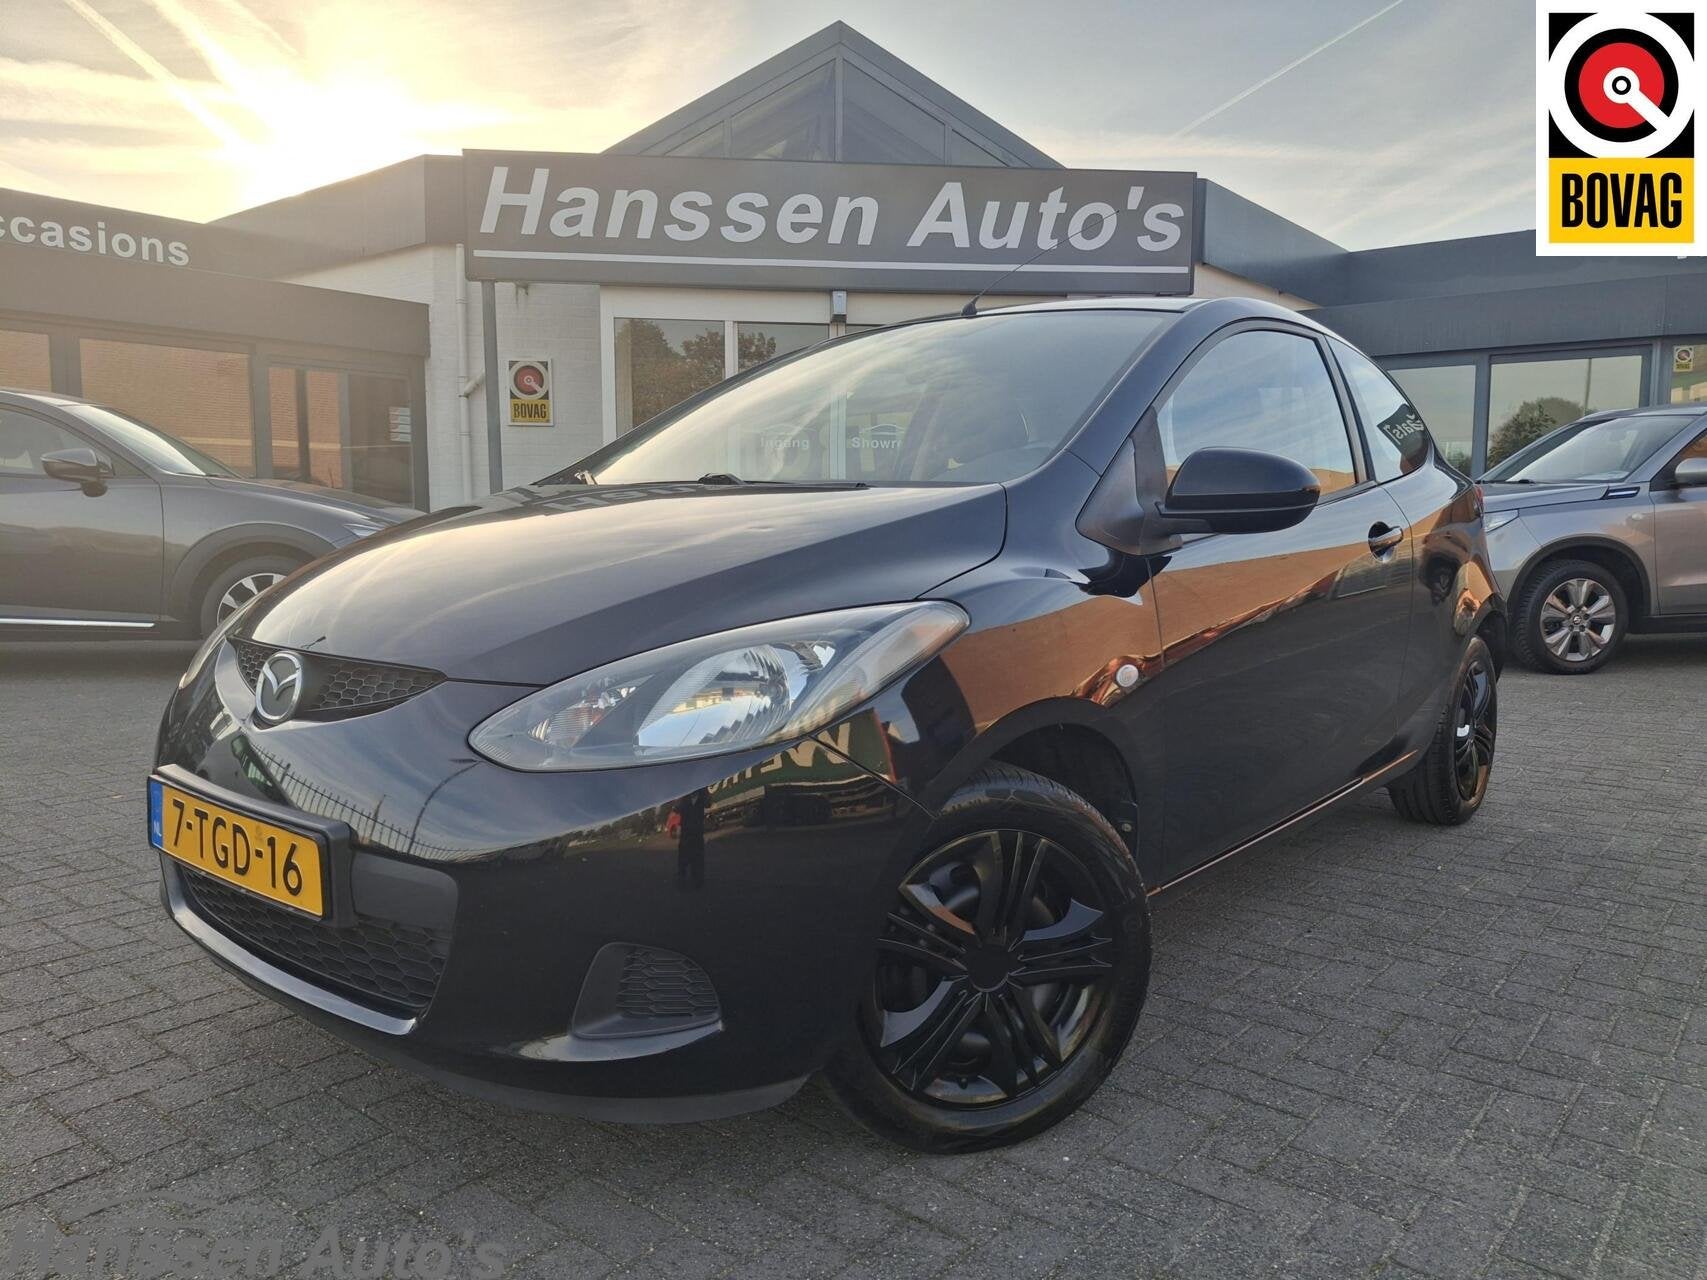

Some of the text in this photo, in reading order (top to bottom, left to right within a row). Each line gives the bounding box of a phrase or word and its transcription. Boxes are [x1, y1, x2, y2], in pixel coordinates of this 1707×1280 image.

[0, 215, 191, 267] casions
[479, 165, 1186, 252] Hanssen Auto's
[512, 403, 547, 419] BOVAG
[172, 798, 303, 897] 7-TGD-16
